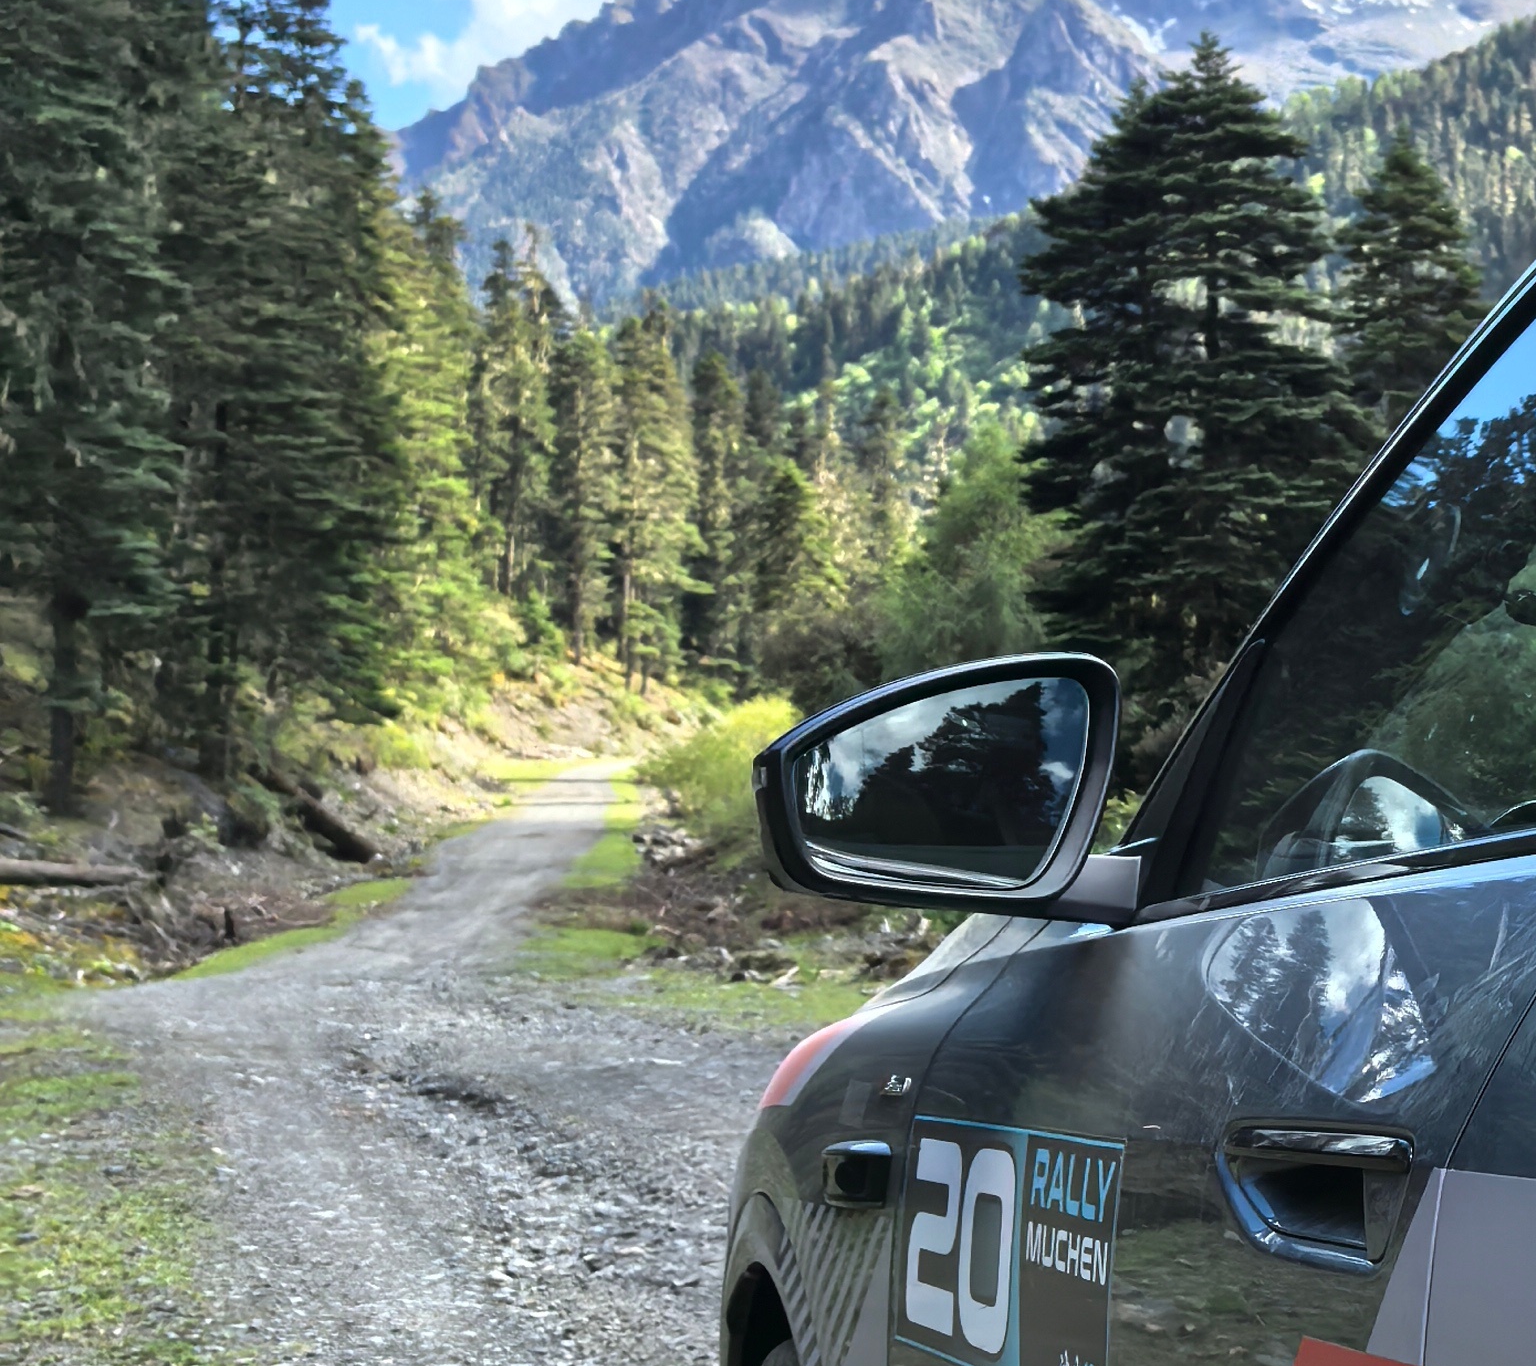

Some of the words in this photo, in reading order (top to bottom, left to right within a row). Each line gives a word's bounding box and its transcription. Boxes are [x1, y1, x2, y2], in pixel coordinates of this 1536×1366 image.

[1030, 1148, 1117, 1223] RALLY
[905, 1137, 1016, 1355] 20
[1025, 1220, 1109, 1286] MUCHEN
